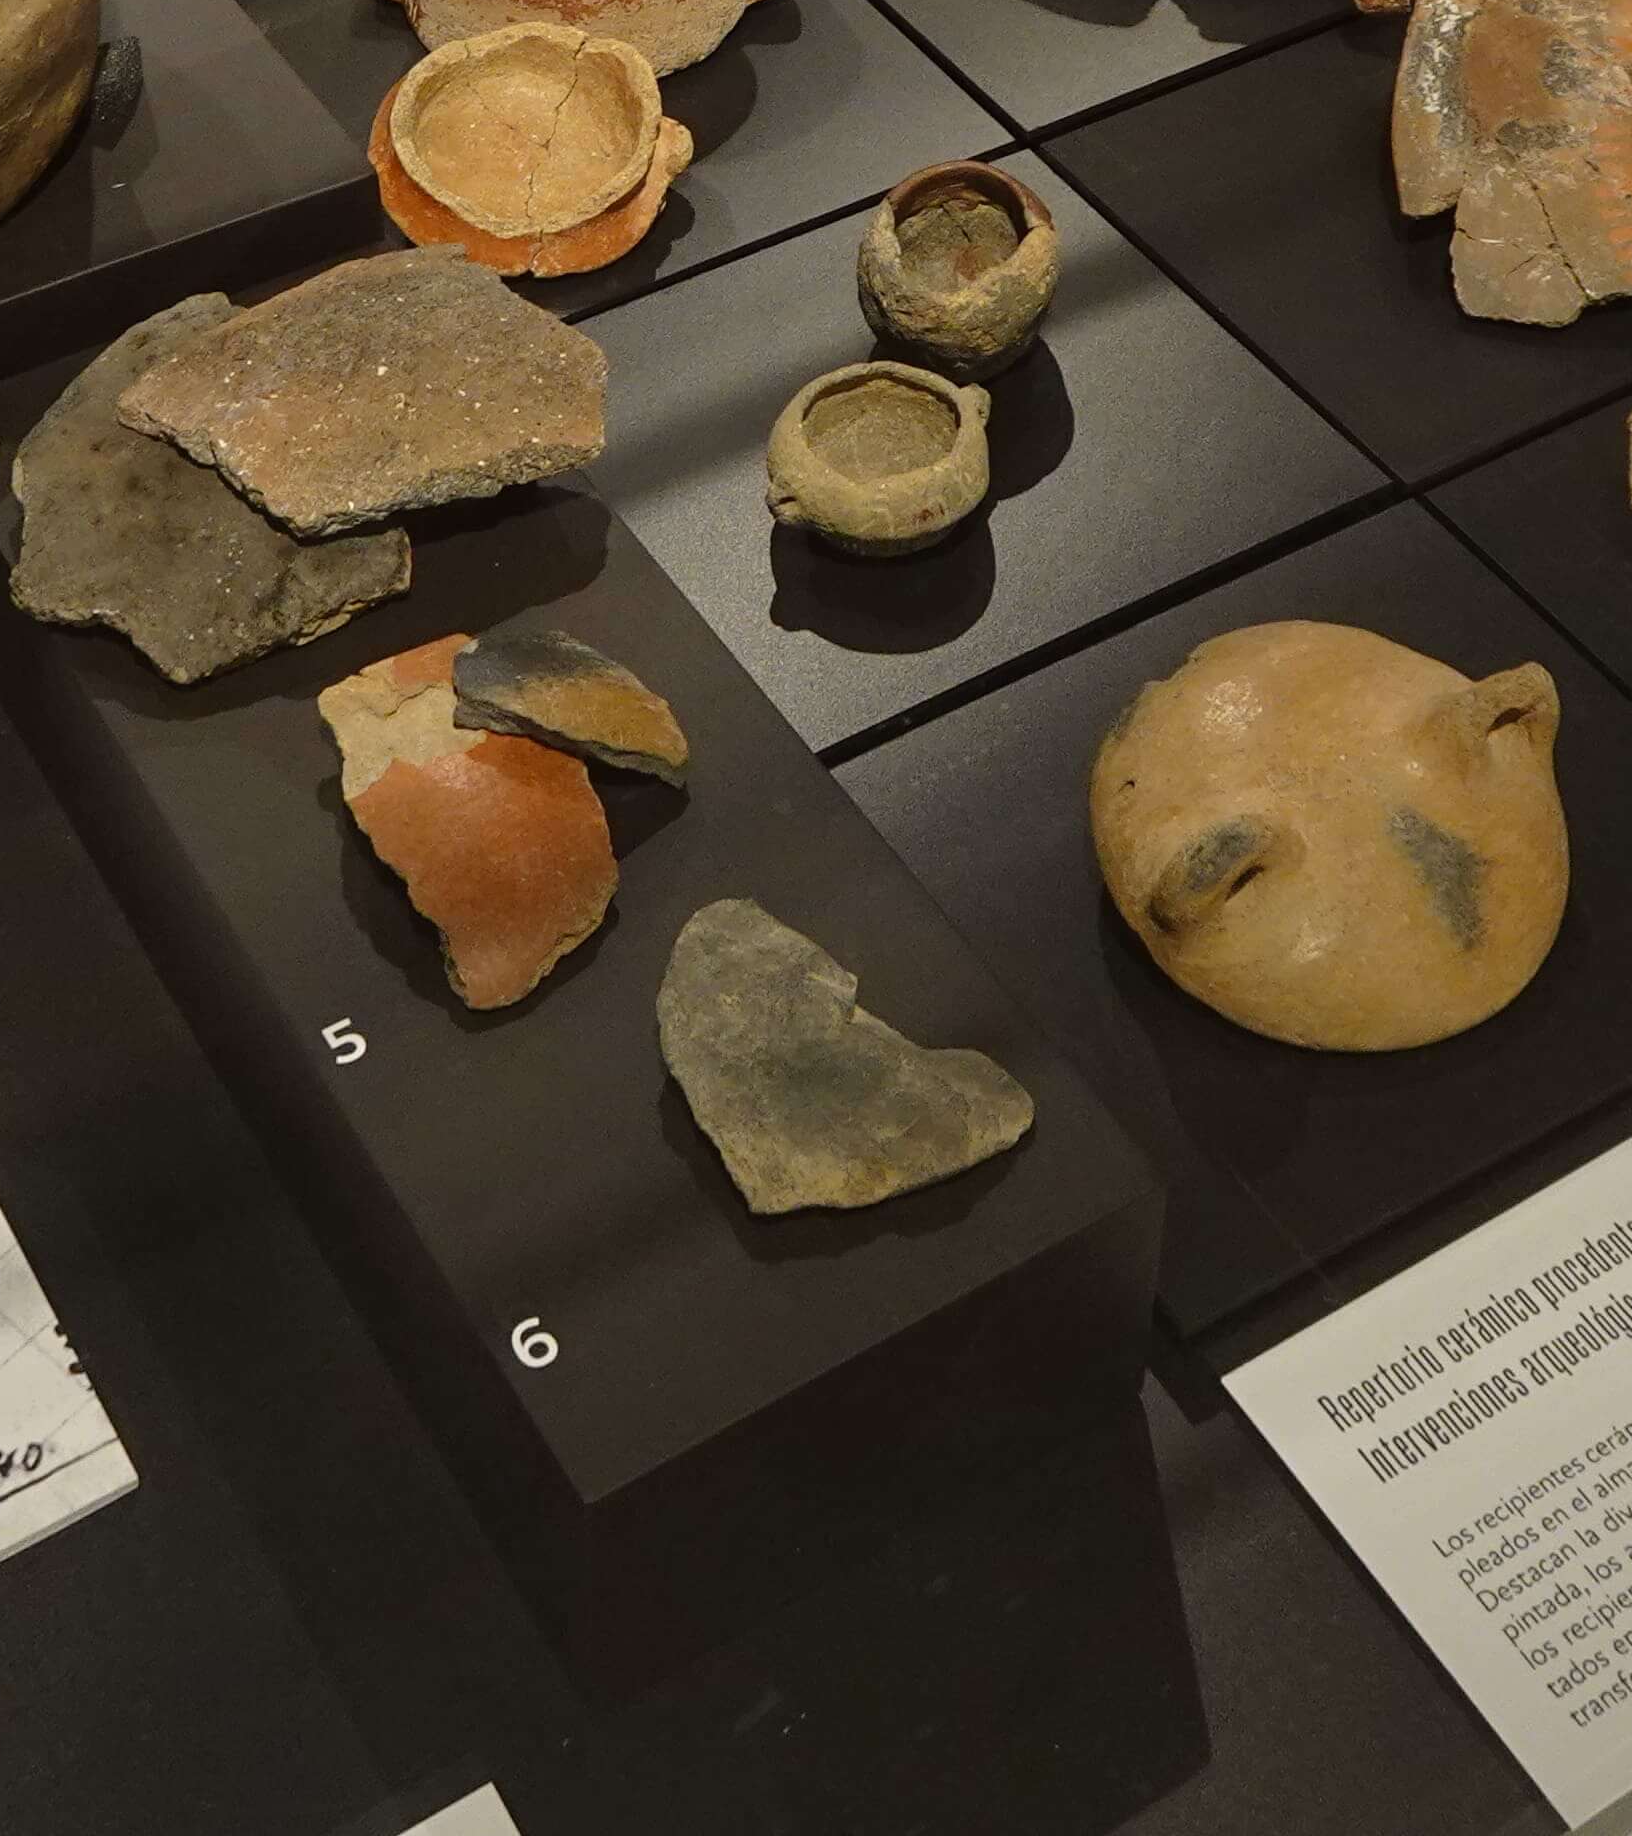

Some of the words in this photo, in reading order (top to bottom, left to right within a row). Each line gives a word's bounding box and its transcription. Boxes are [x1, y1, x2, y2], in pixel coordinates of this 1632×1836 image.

[320, 1017, 368, 1065] 5
[510, 1315, 560, 1370] 6
[1315, 1343, 1446, 1434] Repertorio
[1435, 1287, 1542, 1364] cerámico
[1355, 1366, 1531, 1485] Intervenciones
[1430, 1527, 1476, 1559] Los
[1473, 1456, 1587, 1535] recipientes
[1456, 1526, 1541, 1593] pleados
[1540, 1507, 1571, 1533] en
[1570, 1486, 1594, 1513] el
[1474, 1543, 1578, 1614] Destacan
[1572, 1528, 1602, 1549] la
[1500, 1582, 1592, 1649] pintada,
[1582, 1555, 1624, 1585] los
[1518, 1640, 1560, 1671] los
[1545, 1650, 1611, 1700] tados
